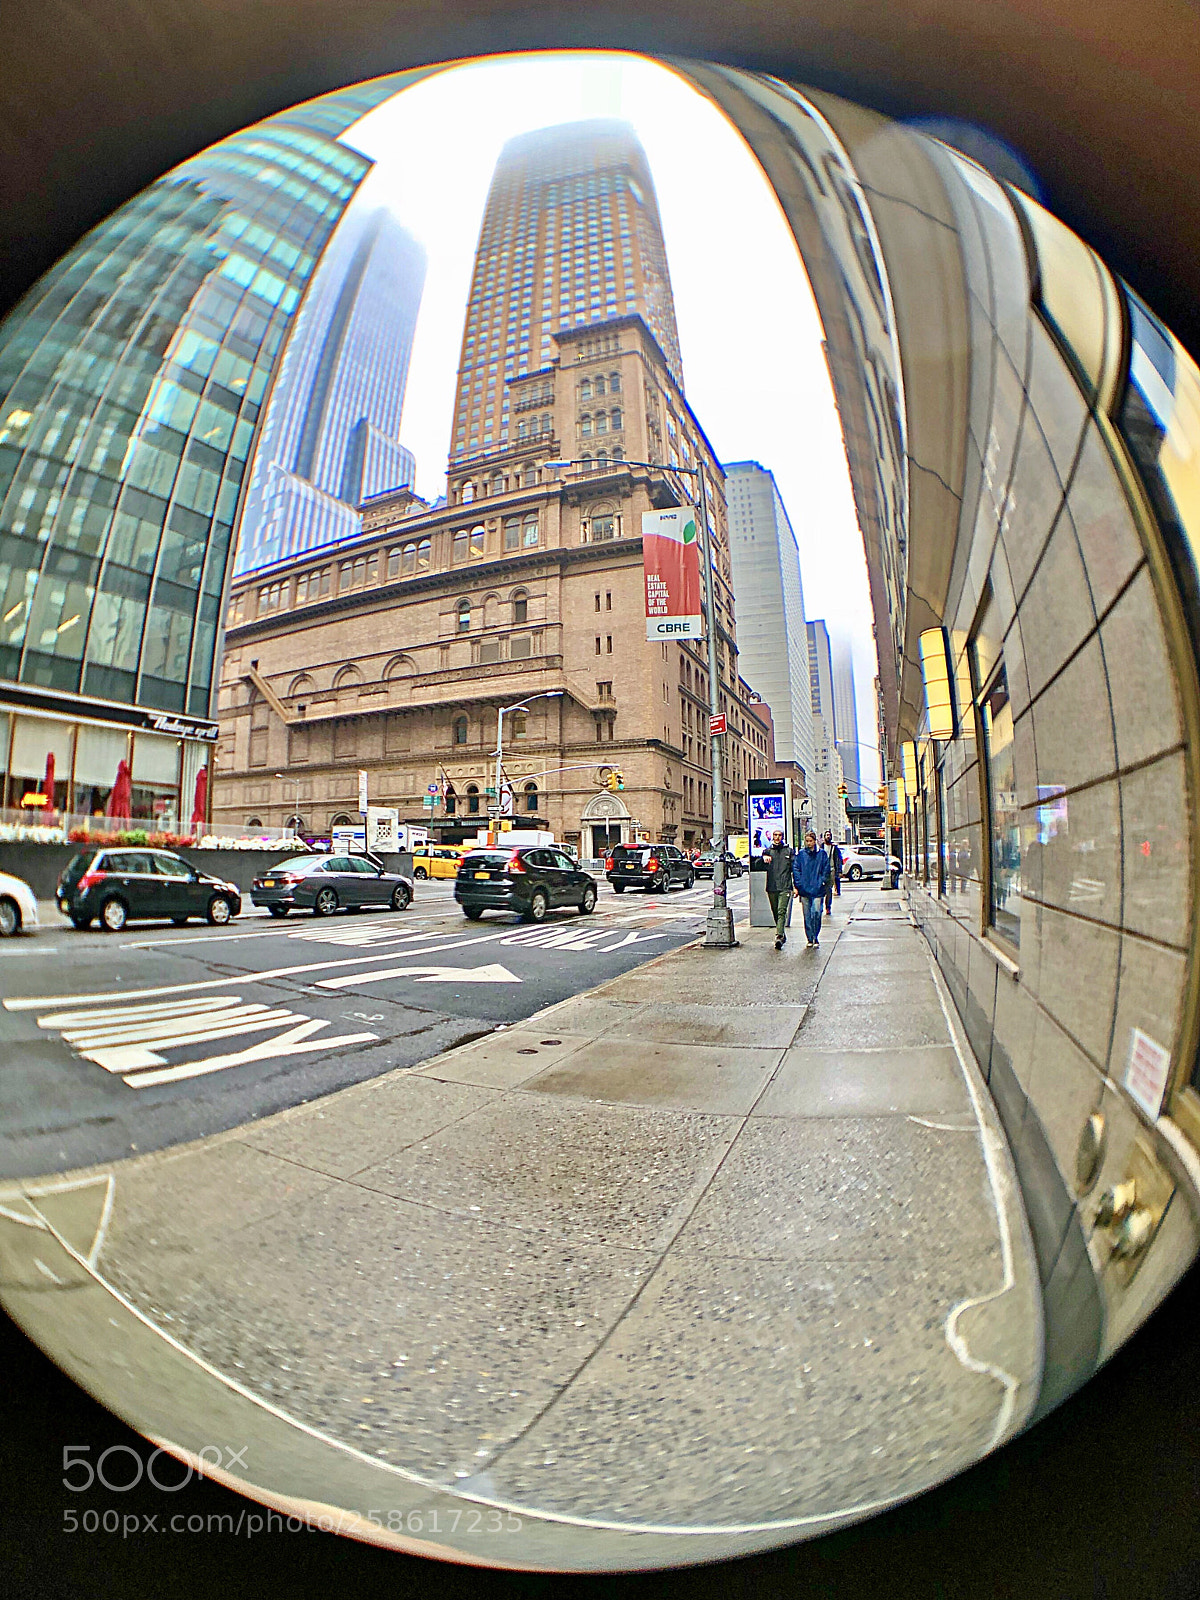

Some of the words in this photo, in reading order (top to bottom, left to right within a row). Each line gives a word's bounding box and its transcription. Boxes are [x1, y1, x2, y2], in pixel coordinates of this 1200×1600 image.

[647, 574, 660, 582] REAL
[647, 582, 667, 590] ESTATE
[647, 590, 670, 598] CAPITAL
[648, 598, 655, 606] OF
[656, 598, 667, 606] THE
[648, 606, 668, 615] WORLD
[657, 623, 690, 633] CBRE
[500, 927, 668, 953] ONLY
[36, 996, 380, 1090] ONLY
